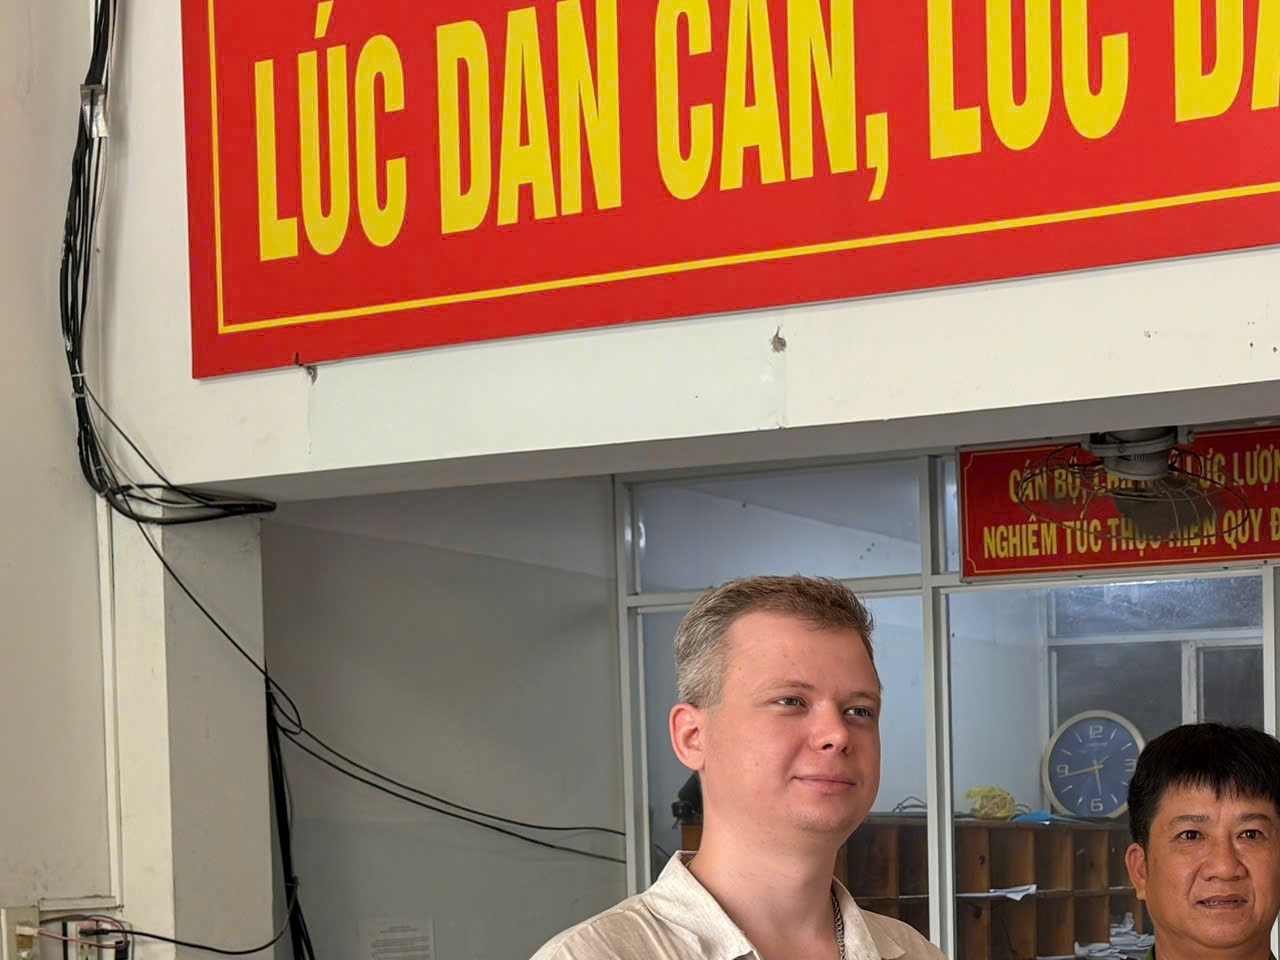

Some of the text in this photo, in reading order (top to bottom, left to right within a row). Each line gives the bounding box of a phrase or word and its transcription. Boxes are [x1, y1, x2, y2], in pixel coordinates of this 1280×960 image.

[255, 1, 405, 262] LÚC
[983, 515, 1057, 560] NGHIÊM
[1223, 508, 1263, 550] QUY
[1089, 725, 1103, 739] 12
[1056, 764, 1069, 778] 9
[1091, 798, 1104, 812] 6
